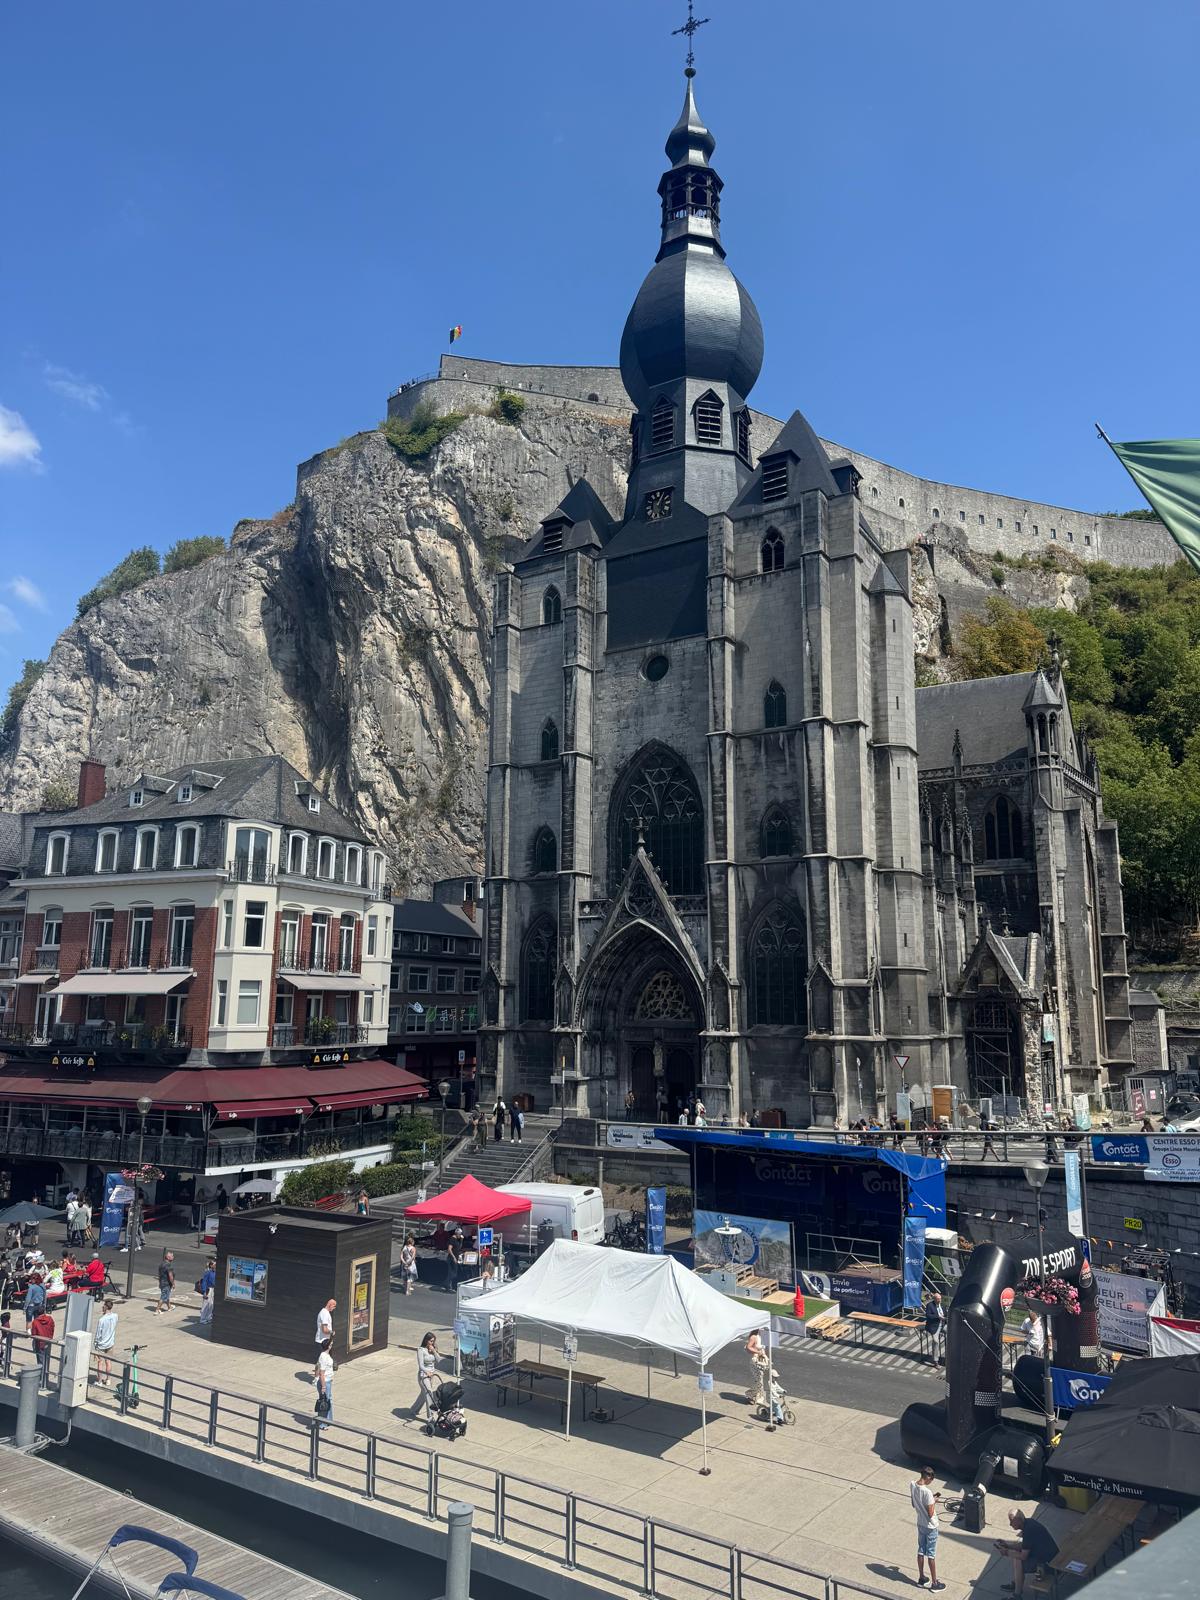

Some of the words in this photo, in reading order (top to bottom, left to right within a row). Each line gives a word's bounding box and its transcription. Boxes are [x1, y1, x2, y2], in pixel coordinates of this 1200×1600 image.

[1048, 1247, 1075, 1274] SPORT
[1097, 1298, 1134, 1313] RELLE
[1112, 1483, 1145, 1496] Namur
